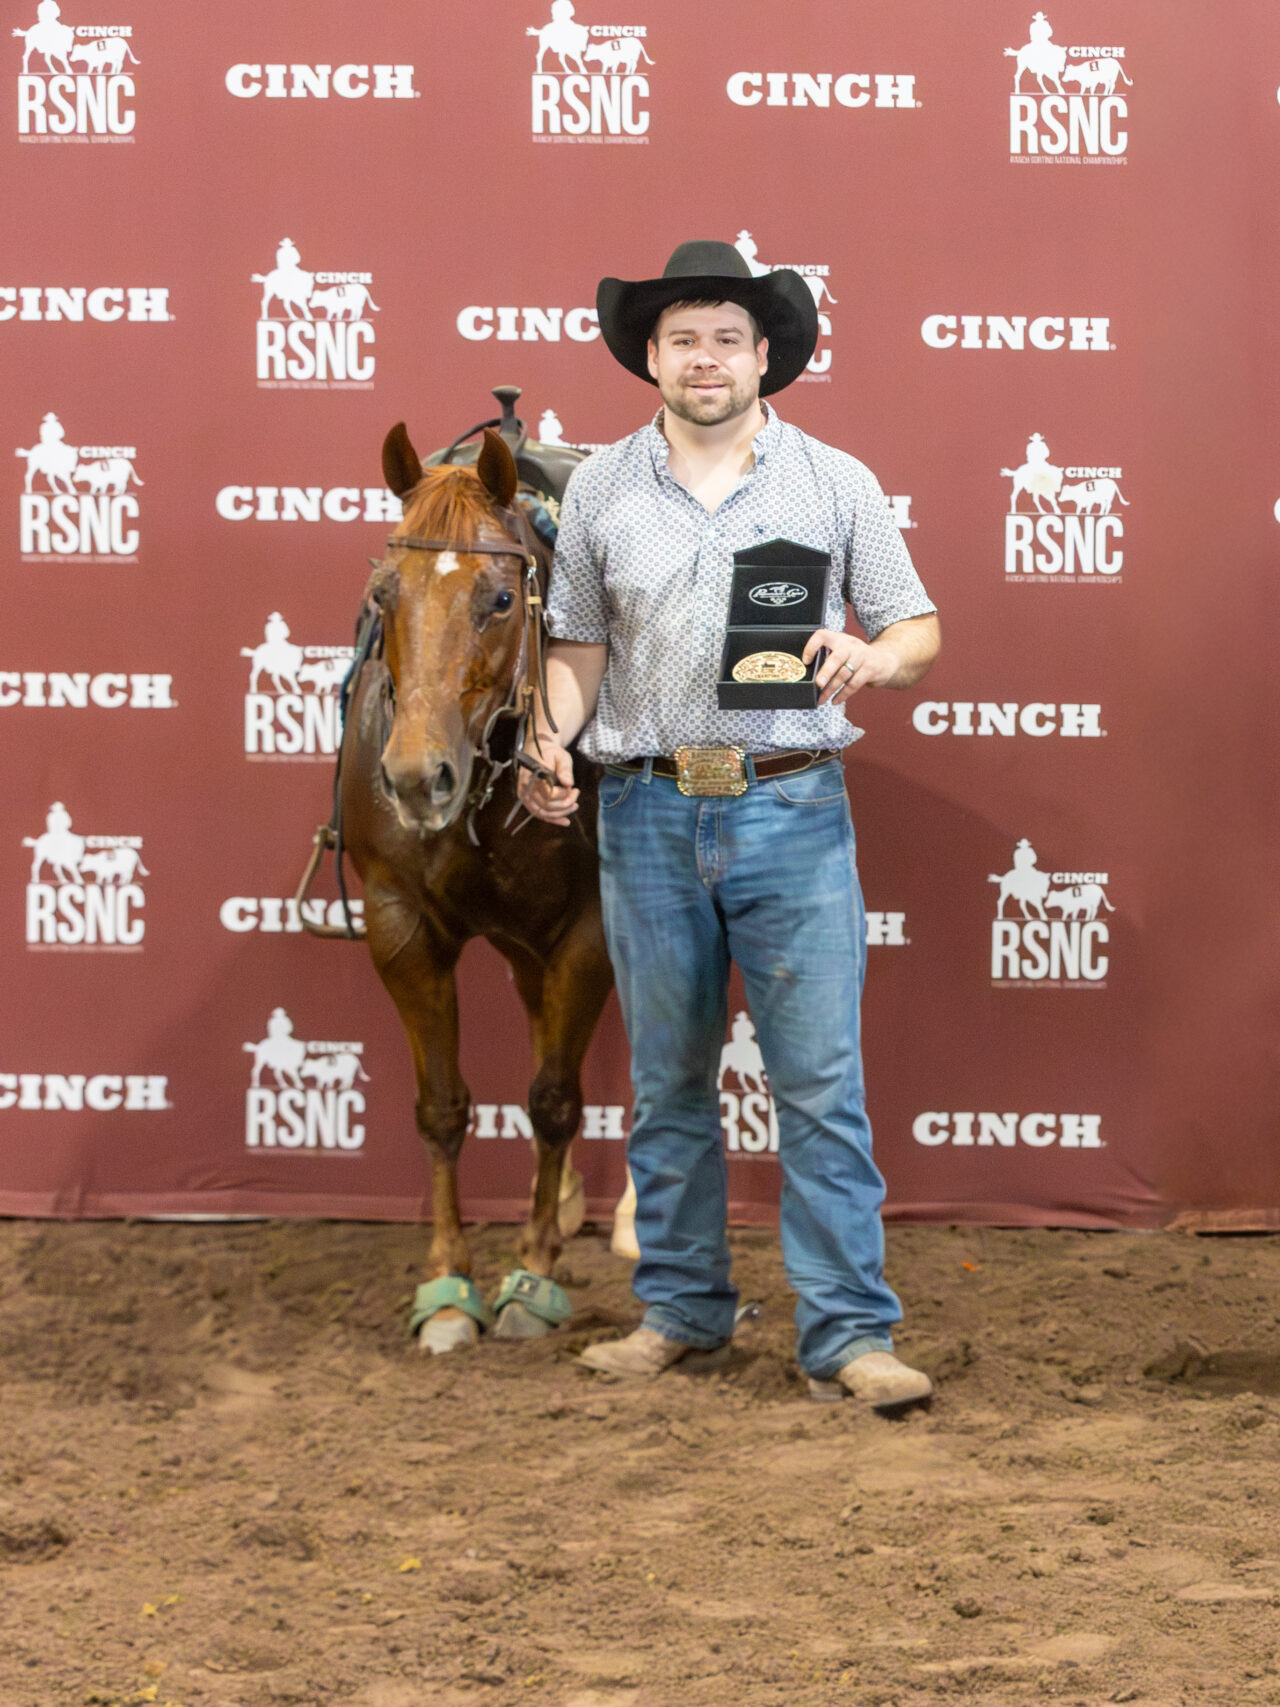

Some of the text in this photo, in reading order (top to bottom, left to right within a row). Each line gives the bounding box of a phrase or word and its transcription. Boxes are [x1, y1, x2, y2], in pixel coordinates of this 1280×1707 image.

[76, 26, 132, 37] CINCH
[590, 26, 646, 37] CINCH
[1069, 46, 1125, 58] CINCH
[224, 63, 415, 99] CINCH
[725, 71, 916, 109] CINCH
[18, 75, 136, 135] RSNC
[531, 74, 650, 135] RSNC
[1009, 95, 1128, 156] RSNC
[315, 272, 372, 284] CINCH
[456, 305, 601, 342] CINC
[920, 314, 1111, 351] CINCH
[256, 320, 375, 381] RSNC
[79, 446, 136, 458] CINCH
[1066, 467, 1122, 478] CINCH
[215, 485, 404, 523] CINCH
[20, 494, 140, 555] RSNC
[1004, 515, 1124, 575] RSNC
[245, 693, 344, 753] RSN
[912, 701, 1102, 738] CINCH
[1052, 872, 1108, 884] CINCH
[26, 882, 146, 945] RSNC
[219, 896, 365, 933] CINC
[991, 920, 1109, 981] RSNC
[246, 1088, 366, 1150] RSNC
[466, 1104, 625, 1140] INH
[719, 1092, 780, 1153] RS
[912, 1111, 1102, 1148] CINCH
